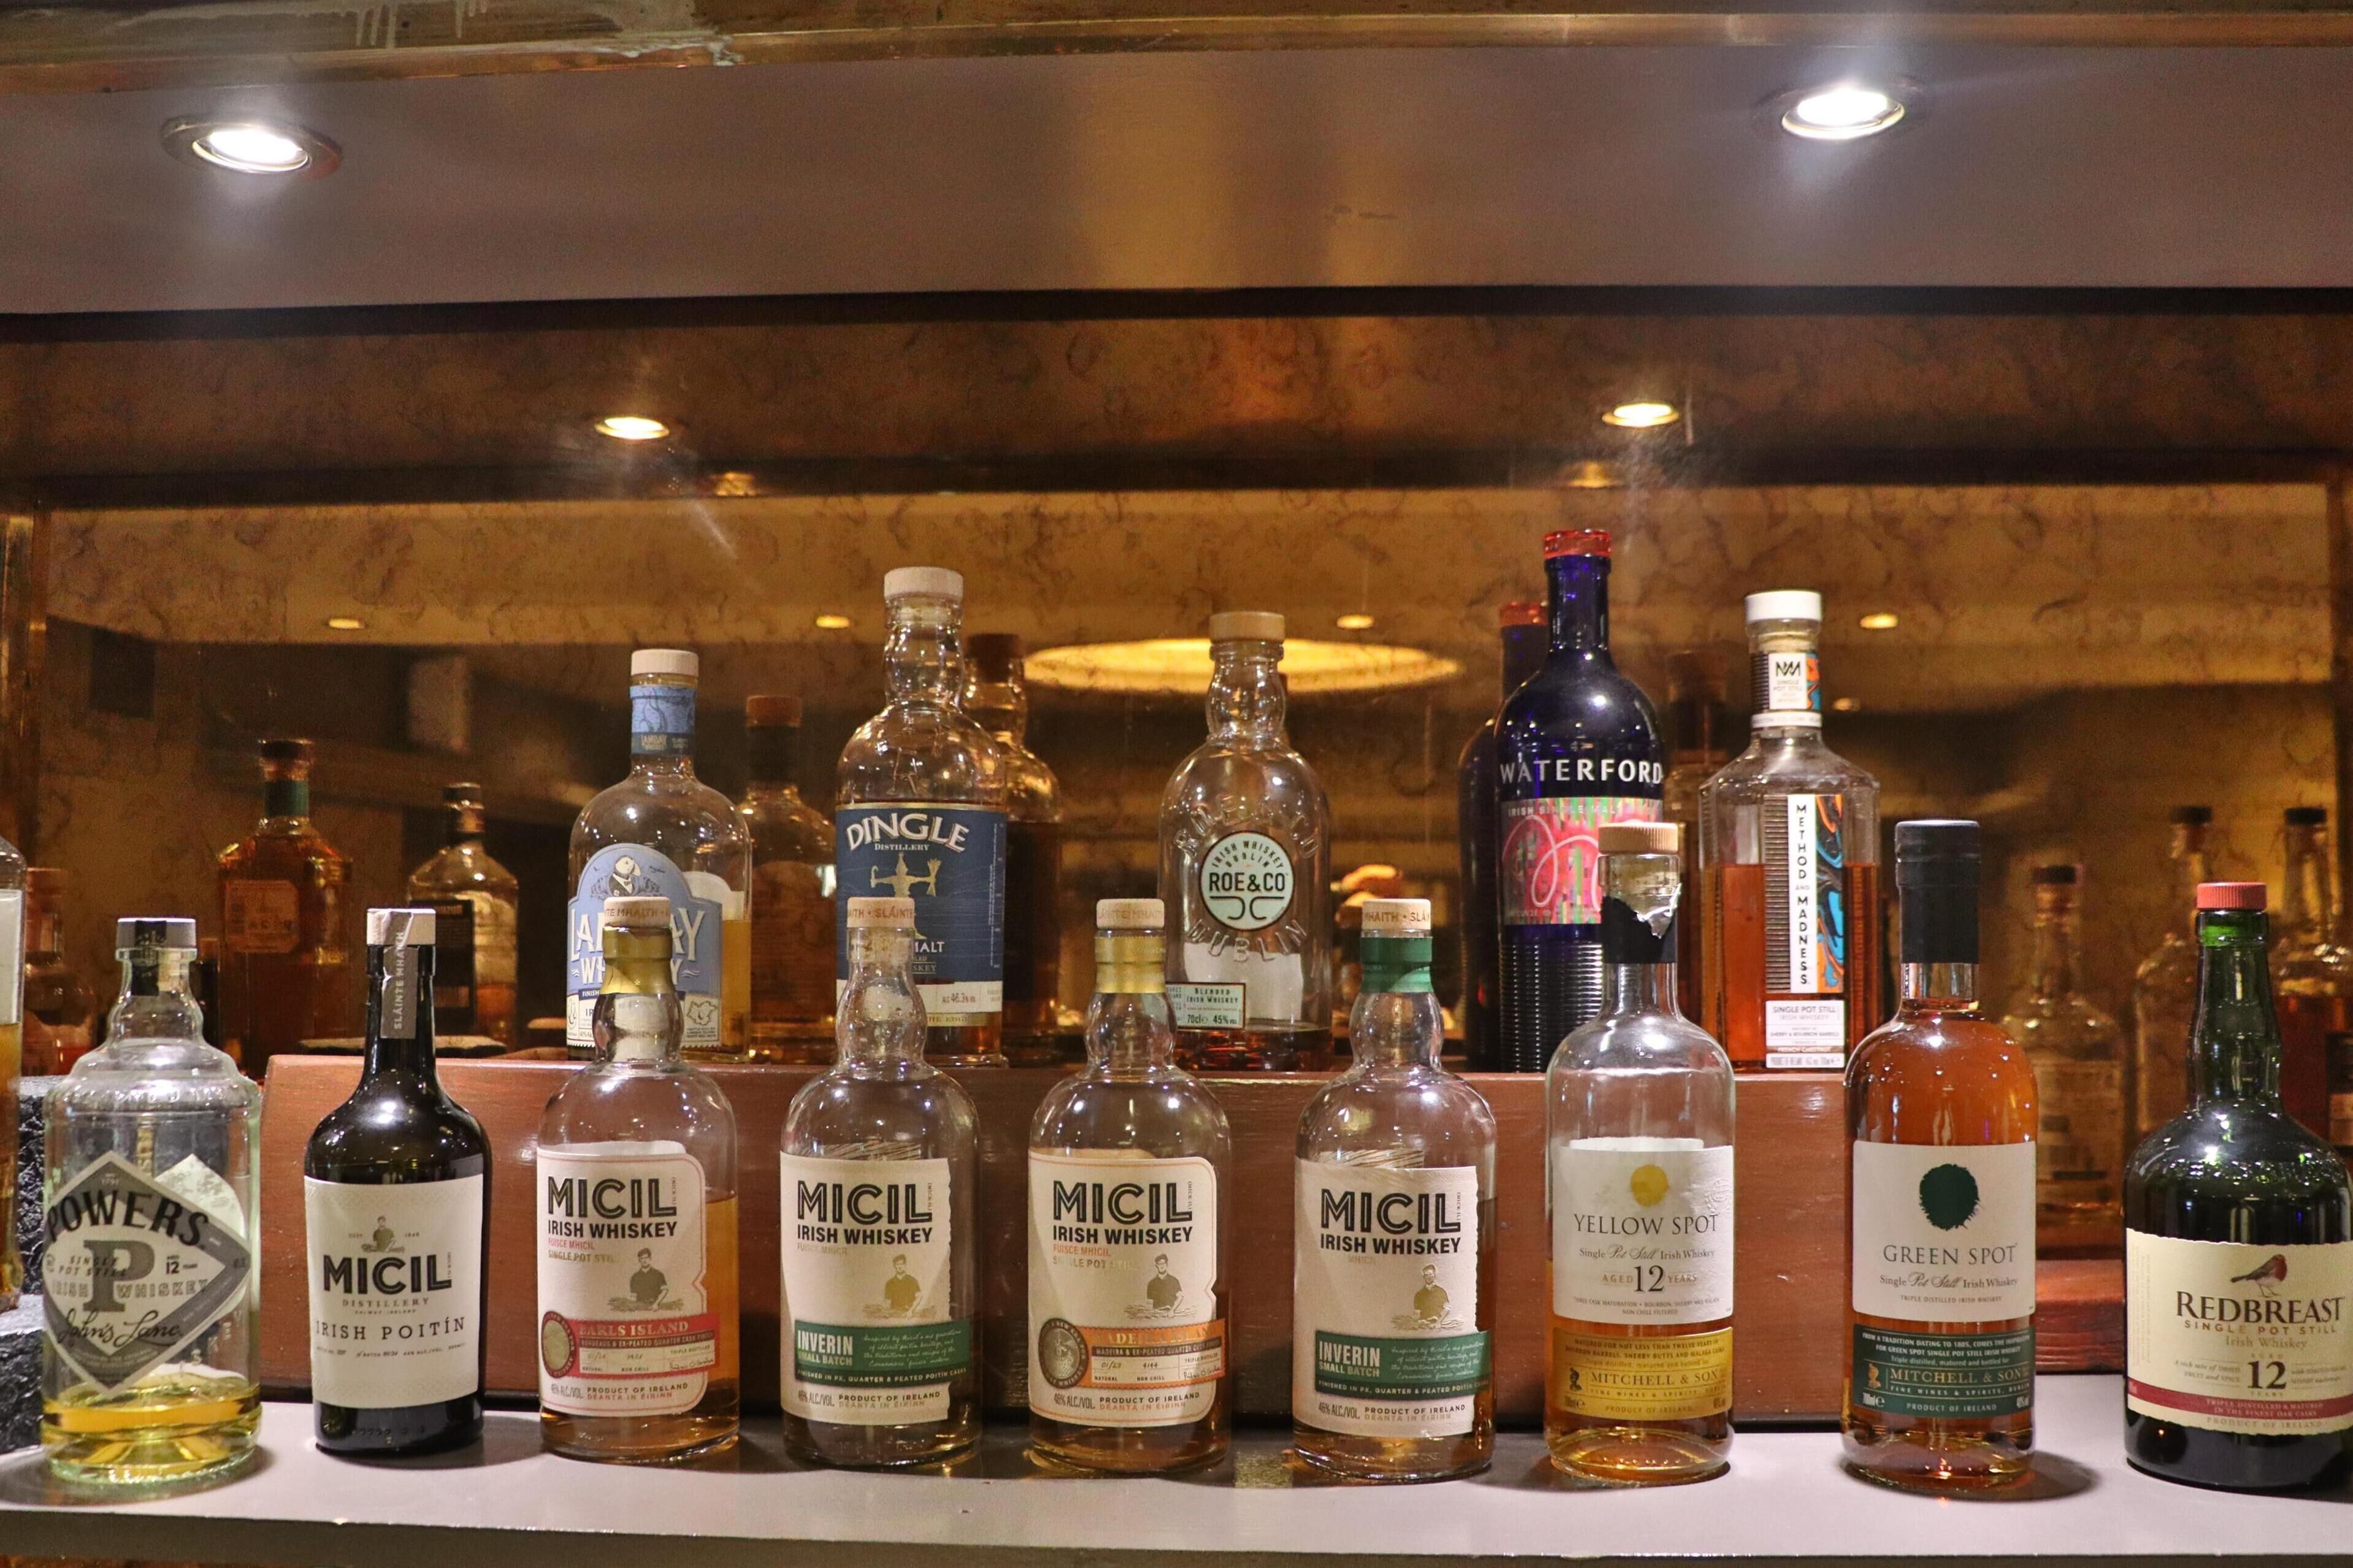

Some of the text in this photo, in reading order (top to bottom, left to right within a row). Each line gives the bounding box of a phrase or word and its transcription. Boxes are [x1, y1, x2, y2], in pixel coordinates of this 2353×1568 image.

[1500, 759, 1662, 784] WATERFORD
[1508, 806, 1533, 816] IRISH
[846, 813, 970, 852] DINGLE
[1796, 805, 1807, 879] METHOD
[1212, 840, 1284, 868] IRISH WHISKEY
[1225, 852, 1270, 868] DUBLIN
[1797, 897, 1808, 985] MADNESS
[393, 980, 404, 1030] SLÁINTE
[1213, 1015, 1228, 1024] 45%
[548, 1176, 678, 1219] MICIL
[797, 1180, 933, 1225] MICIL
[1053, 1180, 1193, 1225] MICIL
[46, 1189, 209, 1246] POWERS
[1321, 1188, 1461, 1234] MICIL
[548, 1220, 678, 1239] IRISH WHISKEY
[1573, 1213, 1718, 1235] YELLOW SPOT
[797, 1224, 933, 1245] IRISH WHISKEY
[1053, 1225, 1193, 1245] IRISH WHISKEY
[1053, 1244, 1112, 1257] FUISCE MHICIL
[1320, 1233, 1461, 1255] IRISH WHISKEY
[1579, 1243, 1715, 1260] Single Pot Still Irish Whiskey
[69, 1256, 117, 1266] SINGLE
[573, 1252, 591, 1263] POT
[1883, 1244, 2016, 1265] GREEN SPOT
[59, 1265, 127, 1277] POT STILL
[166, 1261, 180, 1274] 12
[1086, 1258, 1106, 1269] POT
[323, 1254, 452, 1295] MICIL
[1602, 1264, 1697, 1293] AGED 12 YEARS
[1880, 1271, 2018, 1288] Single Pot Still Irish Whiskey
[52, 1279, 209, 1298] IRISH WHISKEY
[342, 1297, 429, 1307] DISTILLERY
[2176, 1290, 2344, 1325] REDBREAST
[58, 1308, 115, 1346] John's
[316, 1317, 465, 1340] IRISH POITÍN
[630, 1321, 689, 1336] ISLAND
[2184, 1320, 2336, 1335] SINGLE POT STILL
[797, 1329, 853, 1356] INVERIN
[1882, 1336, 1915, 1346] TRADITION
[1916, 1339, 1941, 1347] DATING
[2225, 1335, 2308, 1350] Irish Whiskey
[797, 1351, 852, 1366] SMALL BATCH
[1319, 1340, 1380, 1367] INVERIN
[1888, 1345, 1908, 1354] GREEN
[1967, 1348, 1983, 1357] STILL
[1984, 1347, 2000, 1356] IRISH
[894, 1373, 923, 1382] PEATED
[925, 1370, 948, 1380] POITÍN
[1318, 1363, 1380, 1377] SMALL BATCH
[1591, 1369, 1718, 1386] MITCHELL SON
[1890, 1368, 2021, 1384] MITCHELL SON
[2248, 1360, 2287, 1390] 12
[587, 1385, 629, 1394] PRODUCT
[649, 1382, 688, 1393] IRELAND
[1318, 1380, 1348, 1391] FINISHED
[903, 1391, 941, 1401] IRELAND
[1164, 1392, 1200, 1402] IRELAND
[1364, 1407, 1409, 1415] PRODUCT
[1429, 1404, 1466, 1413] IRELAND
[1605, 1405, 1642, 1413] PRODUCT
[1906, 1402, 1945, 1412] PRODUCT
[1963, 1404, 1997, 1412] IRELAND
[2238, 1401, 2281, 1410] DISTILLED
[2207, 1417, 2322, 1428] PRODUCT OF IRELAND
